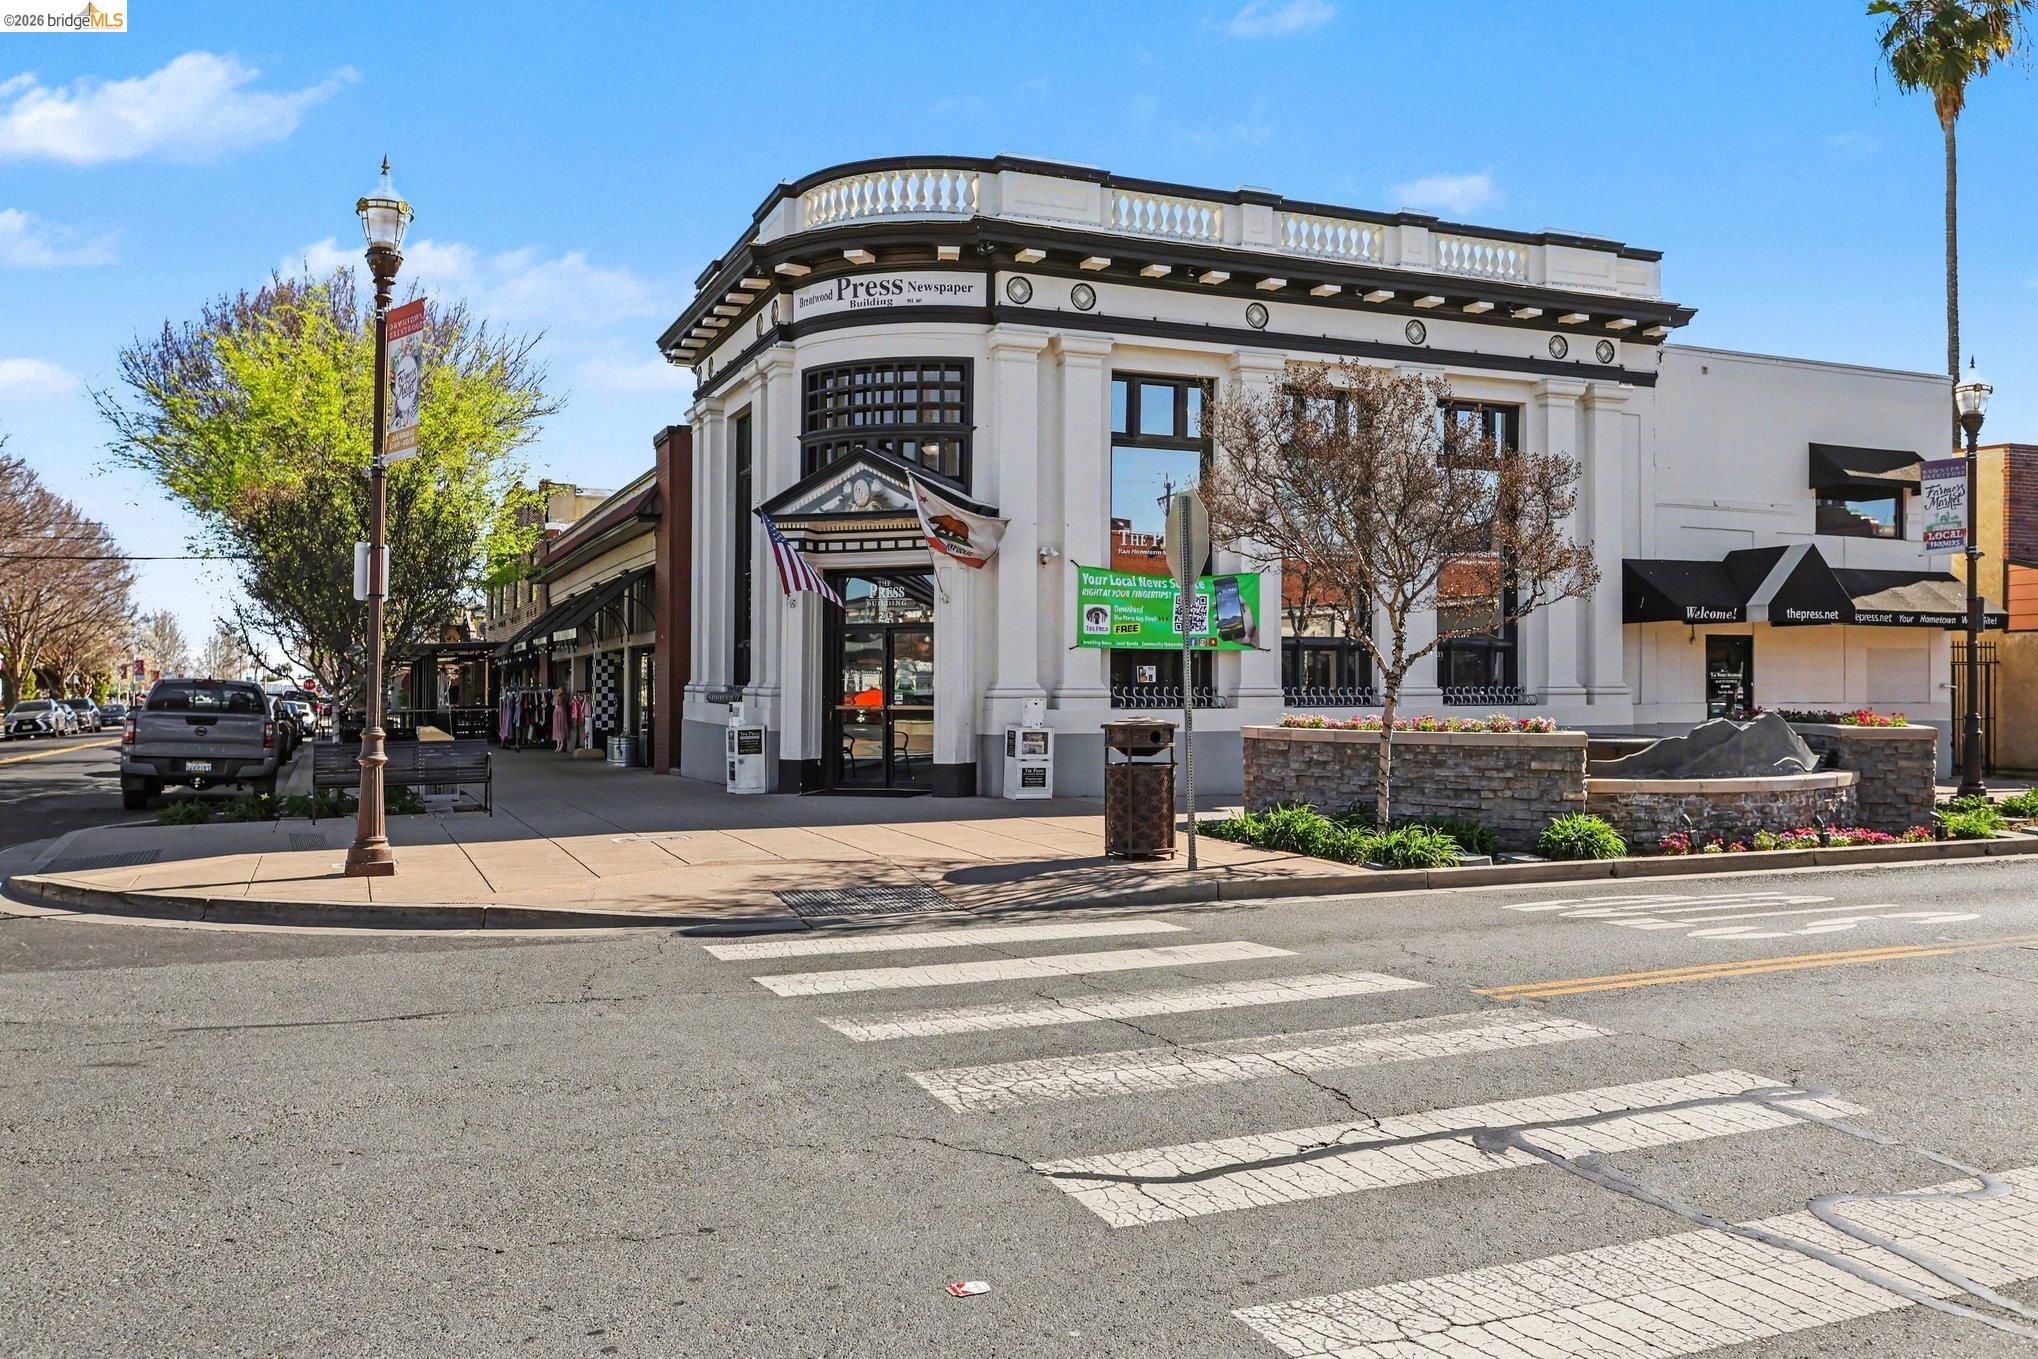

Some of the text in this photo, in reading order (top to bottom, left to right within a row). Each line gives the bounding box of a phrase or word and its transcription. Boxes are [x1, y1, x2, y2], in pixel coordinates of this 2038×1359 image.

[799, 278, 974, 309] Brentwood Press Newspaper
[849, 297, 894, 309] Building
[1925, 484, 1965, 498] Farmers
[1923, 493, 1963, 510] Market
[1117, 530, 1148, 547] THE
[1928, 530, 1963, 541] LOCAL
[1081, 572, 1108, 586] Your
[1109, 574, 1136, 587] Local
[1138, 576, 1168, 589] News
[868, 584, 905, 599] PRESS
[1081, 588, 1172, 599] RIGHT AT YOUR FINGERTIPS!
[1113, 604, 1144, 614] Download
[1686, 606, 1738, 620] Welcome!
[1786, 607, 1839, 621] thepress.net
[1854, 612, 1893, 623] epress.net
[1899, 614, 1915, 623] Your
[1919, 614, 1957, 624] Hometown
[1115, 624, 1139, 634] FREE
